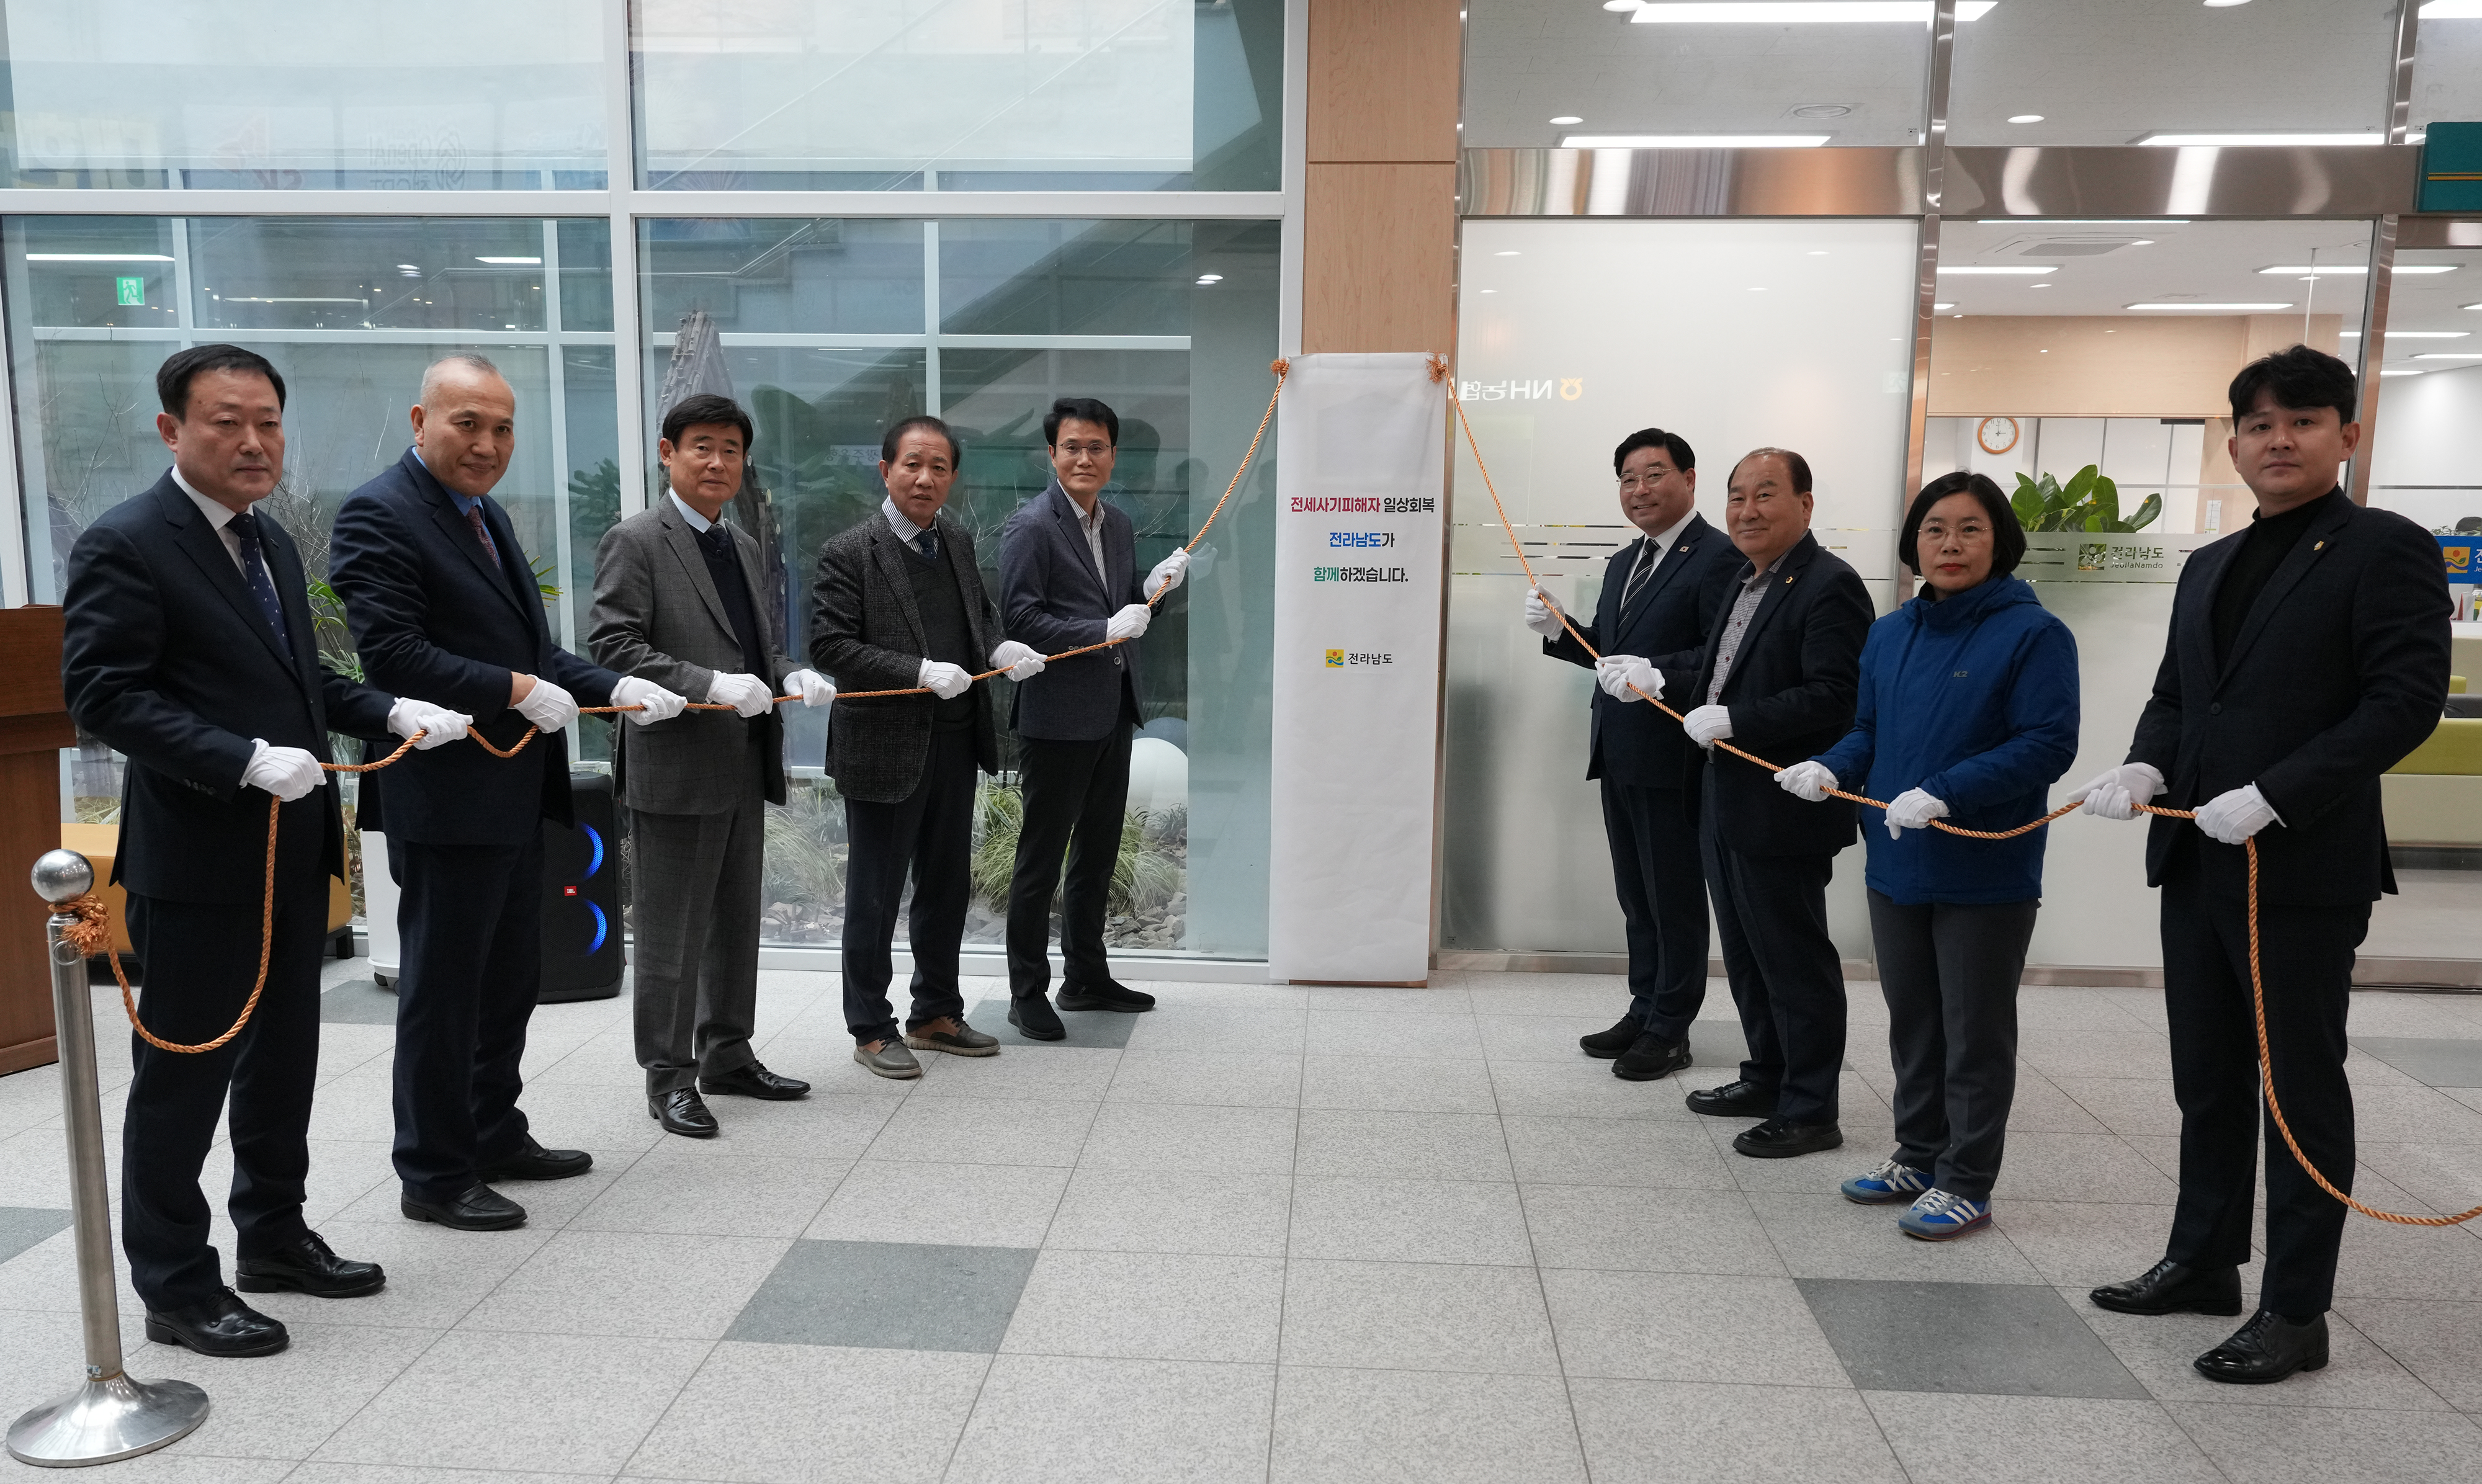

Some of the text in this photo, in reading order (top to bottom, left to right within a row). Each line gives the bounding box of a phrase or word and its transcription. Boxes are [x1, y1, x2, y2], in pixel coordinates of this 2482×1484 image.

[1291, 497, 1435, 513] 전세사기피해자 일상회복
[1329, 532, 1396, 548] 전라남도가
[2111, 547, 2164, 560] 전라남도
[1314, 566, 1409, 583] 함께하겠습니다.
[1348, 653, 1393, 665] 전라남도
